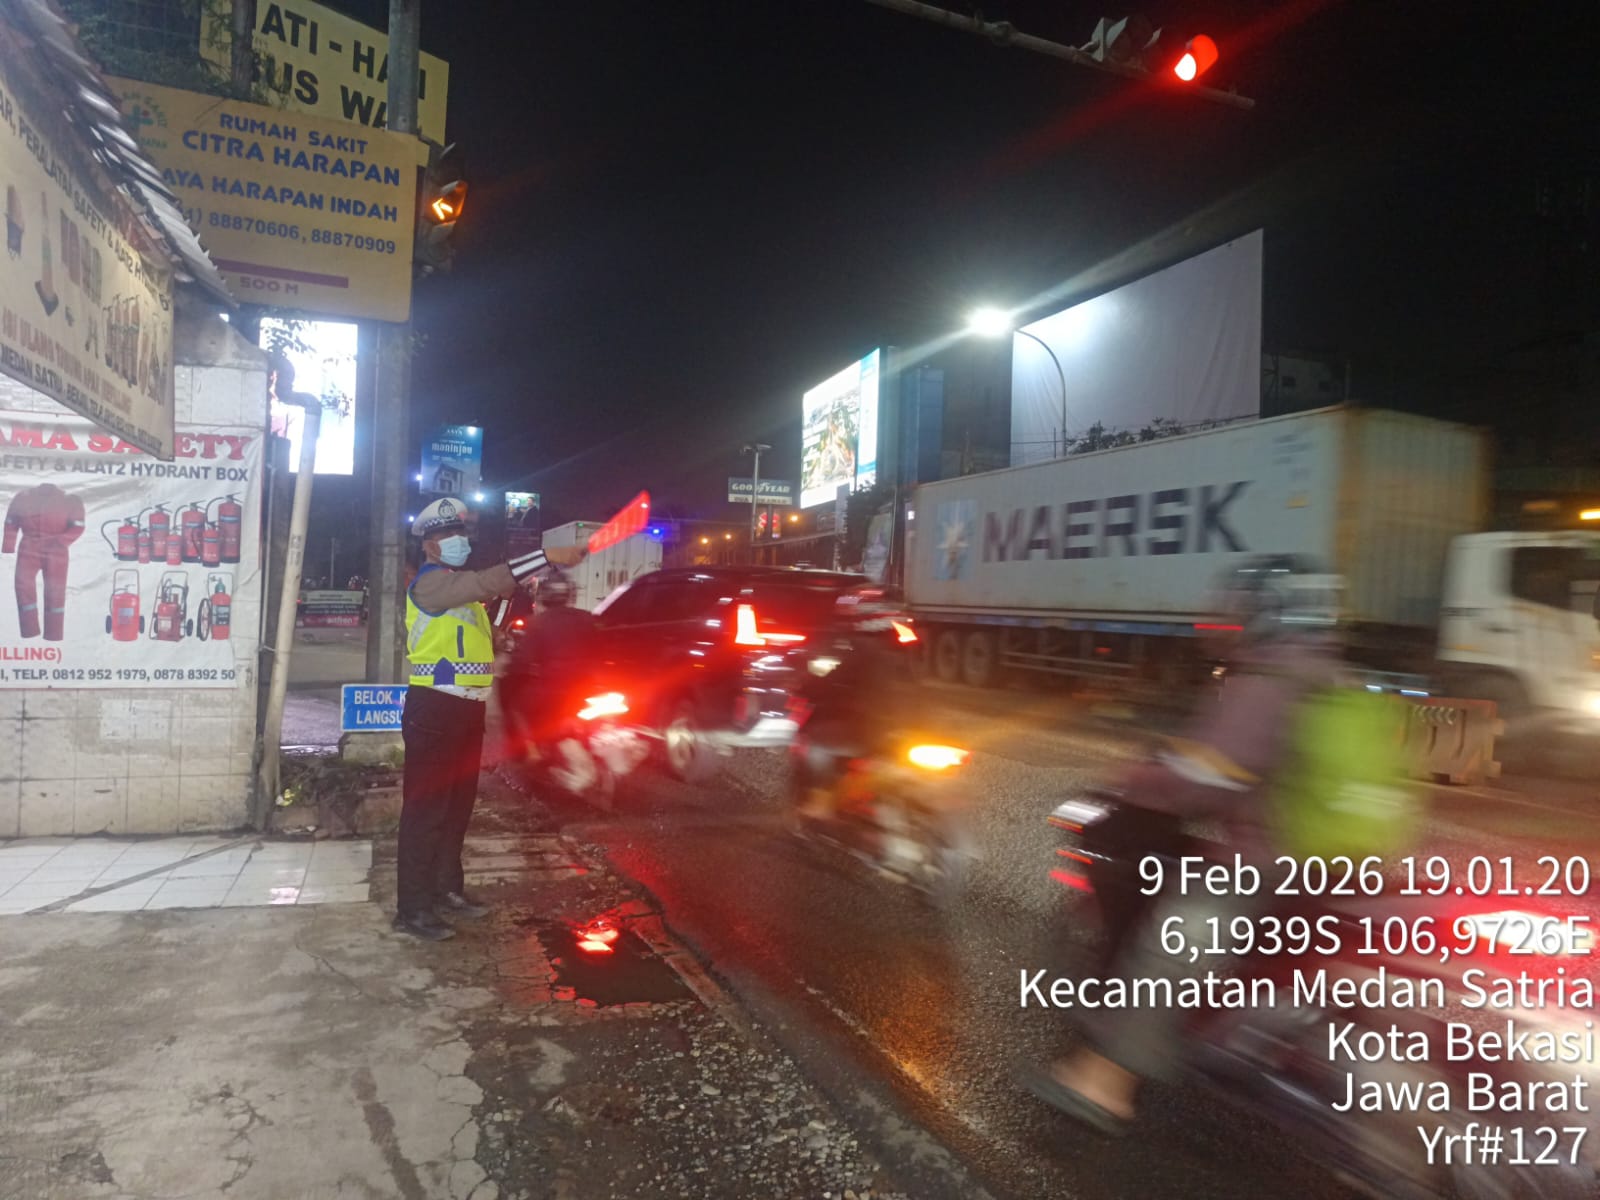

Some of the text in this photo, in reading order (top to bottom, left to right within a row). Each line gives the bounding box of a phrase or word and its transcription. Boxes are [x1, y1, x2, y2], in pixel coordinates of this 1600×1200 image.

[251, 0, 318, 55] ATI
[340, 85, 388, 129] WA
[220, 113, 368, 155] RUMAH SAKIT
[182, 130, 400, 186] CITRA HARAPAN
[162, 168, 398, 223] AYA HARAPAN INDAH
[312, 229, 396, 254] 88870909
[240, 276, 299, 296] 500 M
[88, 428, 253, 460] SAETY
[54, 457, 66, 472] &
[72, 458, 126, 475] ALAT2
[131, 462, 212, 480] HYDRANT
[216, 466, 249, 482] BOX
[732, 482, 790, 493] GOOYEAR
[982, 480, 1255, 562] MAERSK
[0, 647, 62, 664] LLING)
[12, 669, 49, 681] TELP.
[53, 669, 85, 681] 0812
[88, 669, 113, 681] 952
[116, 669, 150, 682] 1979,
[153, 669, 185, 681] 0878
[188, 669, 218, 681] 8392
[221, 669, 236, 681] 50
[354, 690, 393, 705] BELOK
[356, 710, 405, 725] LANGSU
